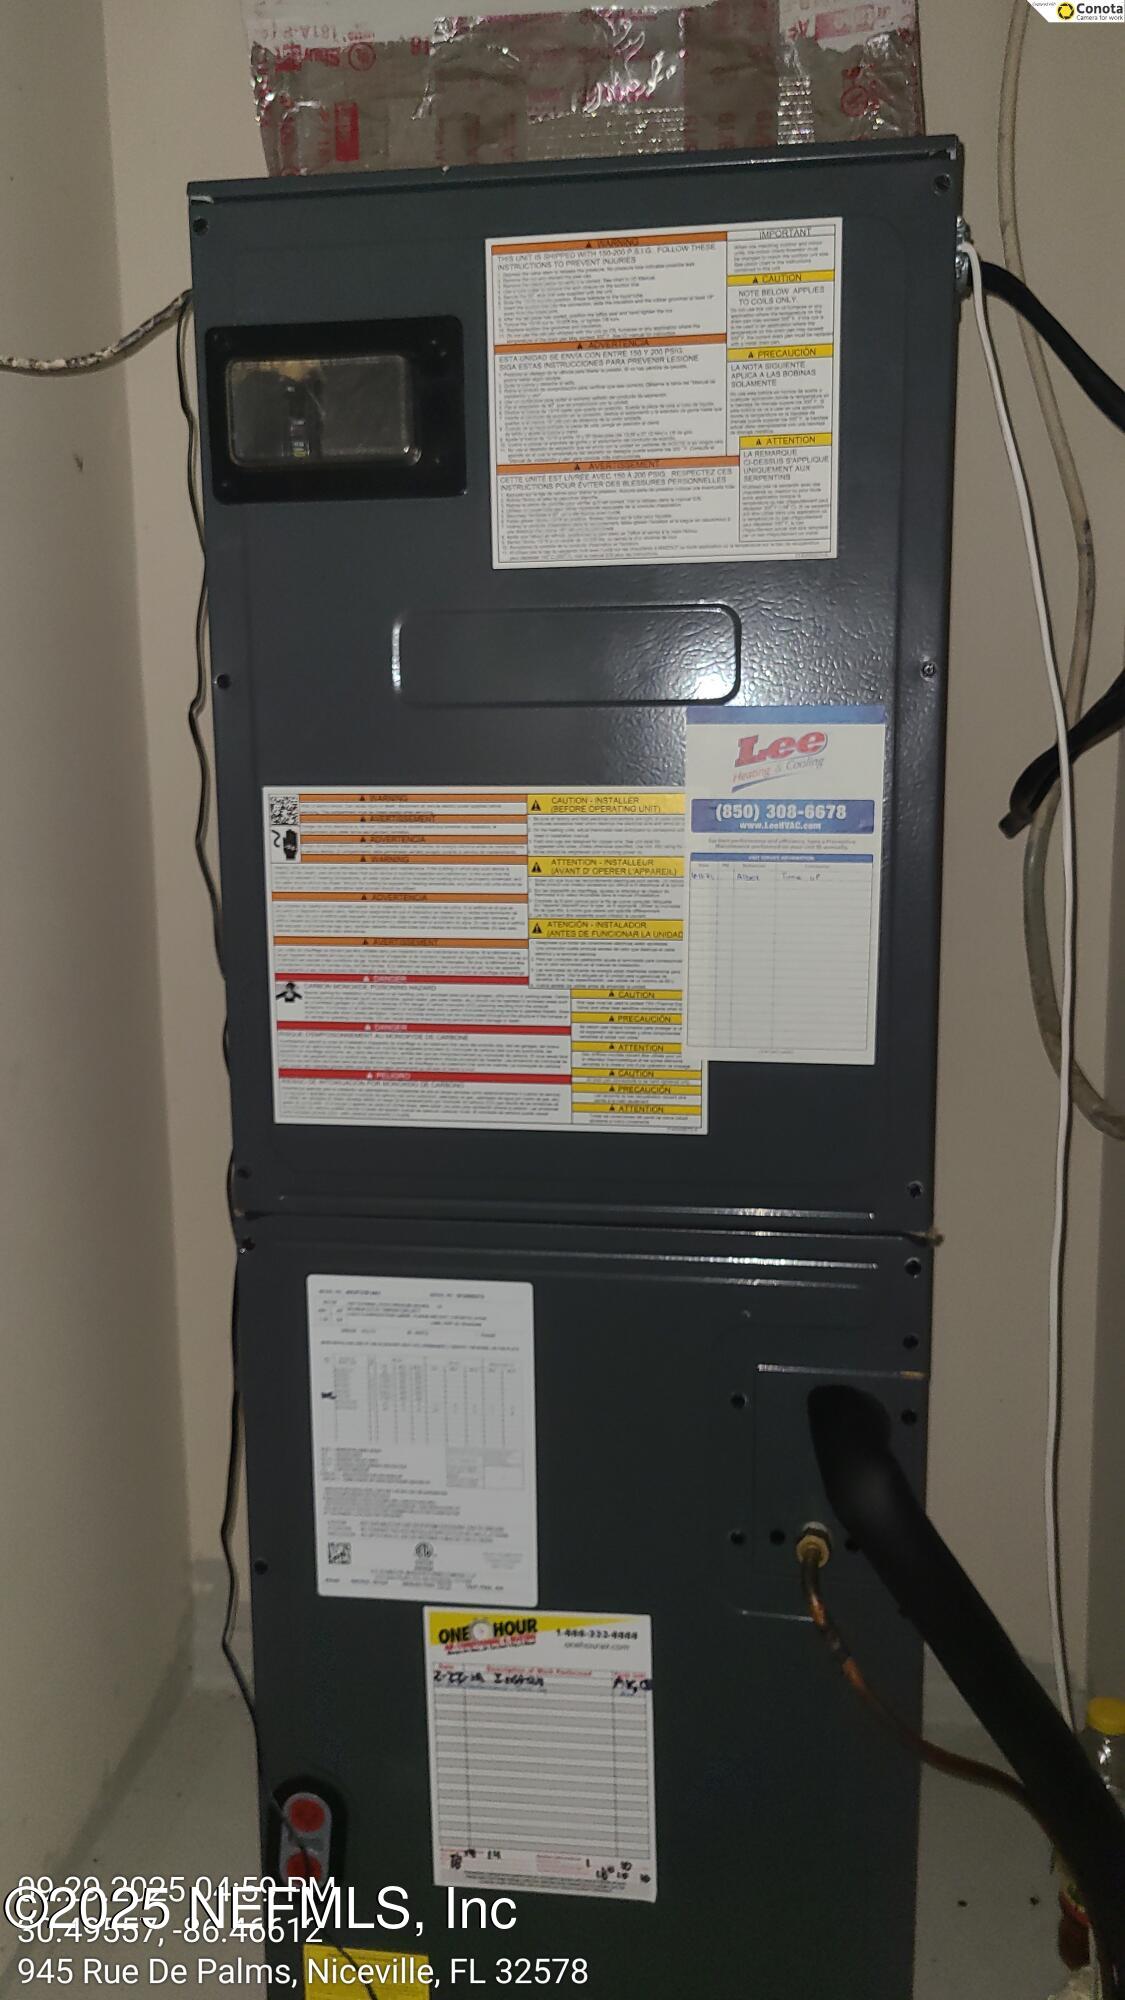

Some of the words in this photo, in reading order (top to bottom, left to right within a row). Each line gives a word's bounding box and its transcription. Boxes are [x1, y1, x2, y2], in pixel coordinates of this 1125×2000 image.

[759, 227, 812, 240] IMPORTANT
[597, 238, 639, 247] WARNING
[498, 255, 515, 263] THIS
[516, 254, 533, 262] UNIT
[543, 252, 576, 260] SHIPPED
[657, 246, 689, 254] FOLLOW
[497, 261, 552, 272] INSTRUCTIONS
[554, 261, 565, 269] TO
[566, 259, 601, 268] PREVENT
[603, 256, 637, 265] INJURIES
[762, 274, 802, 283] CAUTION
[738, 289, 759, 298] NOTE
[761, 288, 790, 297] BELOW
[793, 286, 825, 294] APPLIES
[739, 298, 749, 306] TO
[751, 297, 774, 306] COILS
[588, 339, 650, 349] ADVERTENCIA
[499, 355, 518, 363] ESTA
[519, 354, 548, 362] UNIDAD
[603, 350, 629, 358] ENTRE
[651, 348, 663, 356] 200
[757, 347, 817, 359] PRECAUCIÓN
[518, 362, 542, 370] ESTAS
[544, 360, 604, 370] INSTRUCCIONES
[627, 356, 665, 365] PREVENIR
[742, 363, 763, 371] NOTA
[764, 361, 805, 369] SIGUIENTE
[731, 372, 758, 380] APLICA
[766, 370, 781, 378] LAS
[783, 368, 817, 377] BOBINAS
[730, 379, 777, 388] SOLAMENTE
[765, 436, 817, 446] ATTENTION
[743, 450, 753, 458] LA
[754, 448, 797, 457] REMARQUE
[743, 457, 785, 466] CI-DESSUS
[785, 455, 829, 465] S'APPLIQUE
[588, 460, 660, 472] AVERTISSEMENT
[743, 466, 793, 475] UNIQUEMENT
[794, 465, 811, 473] AUX
[499, 476, 523, 484] CETTE
[548, 474, 562, 482] EST
[592, 472, 612, 480] AVEC
[671, 468, 716, 477] RESPECTEZ
[743, 473, 791, 482] SERPENTINS
[501, 482, 554, 491] INSTRUCTIONS
[555, 481, 576, 489] POUR
[622, 478, 666, 487] BLESSURES
[667, 476, 727, 486] PERSONNELLES
[734, 730, 829, 768] Lee
[733, 766, 771, 783] Heating
[785, 757, 825, 771] Cooling
[550, 805, 586, 813] (BEFORE
[588, 805, 637, 813] OPERATING
[638, 805, 661, 813] UNIT)
[715, 803, 760, 822] (850)
[765, 804, 847, 820] 308-6678
[739, 821, 822, 831] www.LeeHVAC.com
[551, 858, 597, 866] ATTENTION
[551, 867, 582, 876] (AVANT
[547, 920, 589, 929] ATENCIÓN
[547, 930, 577, 938] (ANTES
[591, 930, 640, 938] FUNCIONAR
[617, 991, 656, 999] CAUTION
[617, 1014, 672, 1023] PRECAUCIÓN
[617, 1044, 664, 1052] ATTENTION
[617, 1070, 655, 1078] CAUTION
[617, 1085, 672, 1095] PRECAUCIÓN
[617, 1105, 665, 1114] ATTENTION
[438, 1626, 471, 1645] ONE
[493, 1618, 538, 1637] HOUR
